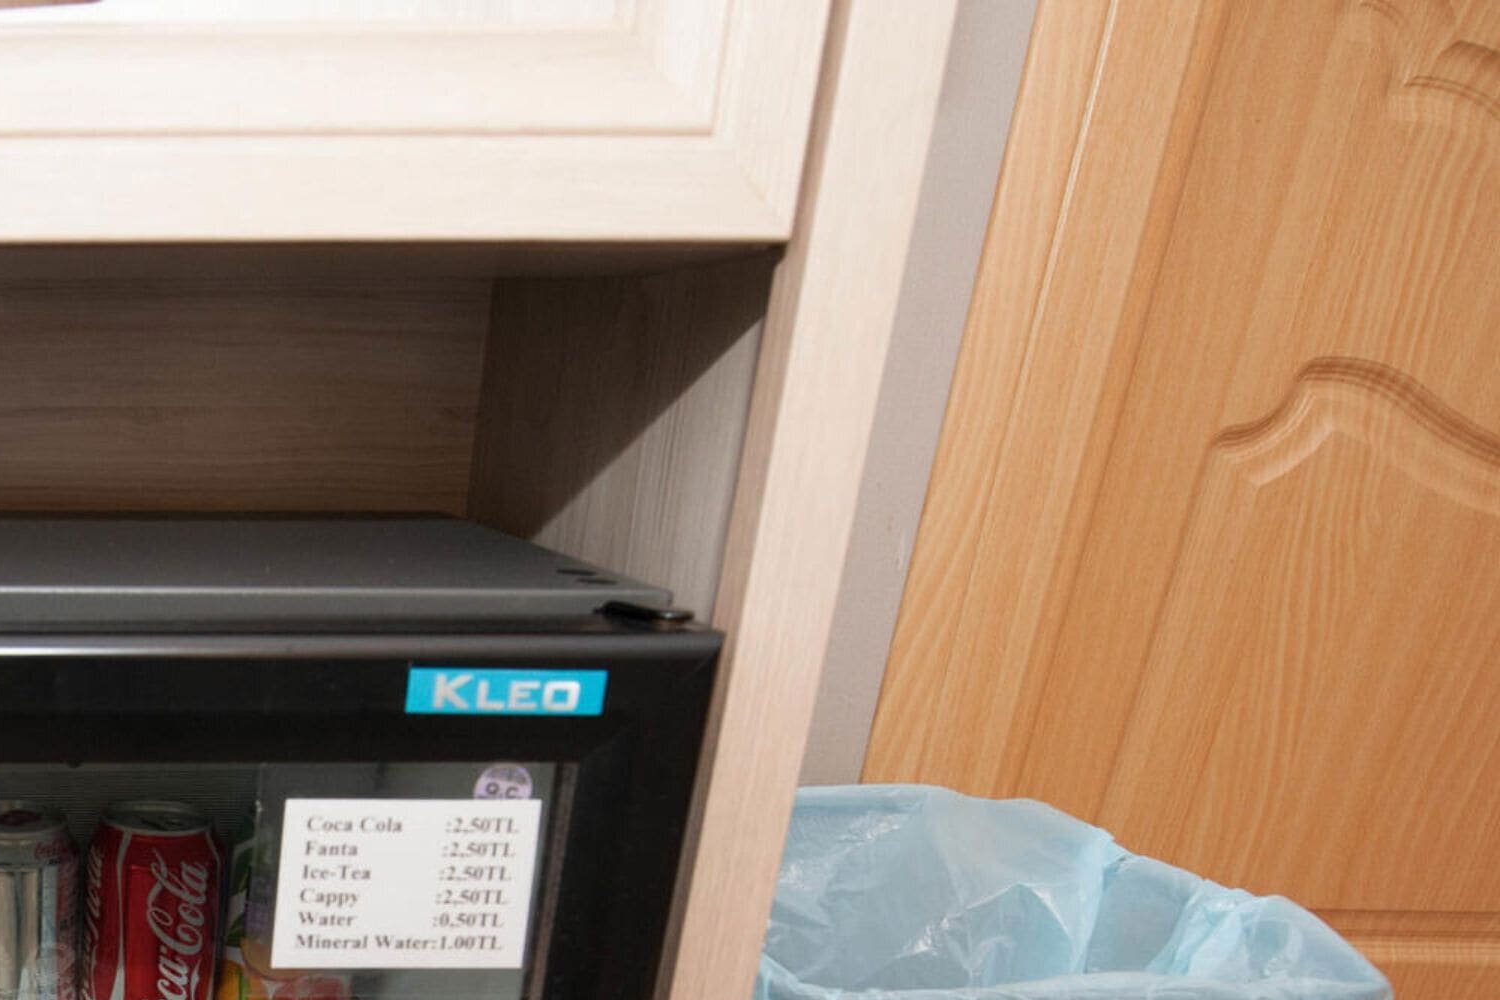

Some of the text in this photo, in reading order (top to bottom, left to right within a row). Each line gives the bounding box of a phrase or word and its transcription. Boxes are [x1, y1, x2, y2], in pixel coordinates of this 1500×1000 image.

[432, 673, 581, 712] KLEO
[306, 816, 353, 833] Coca
[360, 816, 403, 833] Cola
[304, 840, 358, 856] Fanta
[301, 864, 371, 880] Ice-Tea
[299, 888, 360, 908] Cappy
[298, 911, 356, 927] Water
[295, 934, 369, 950] Mineral
